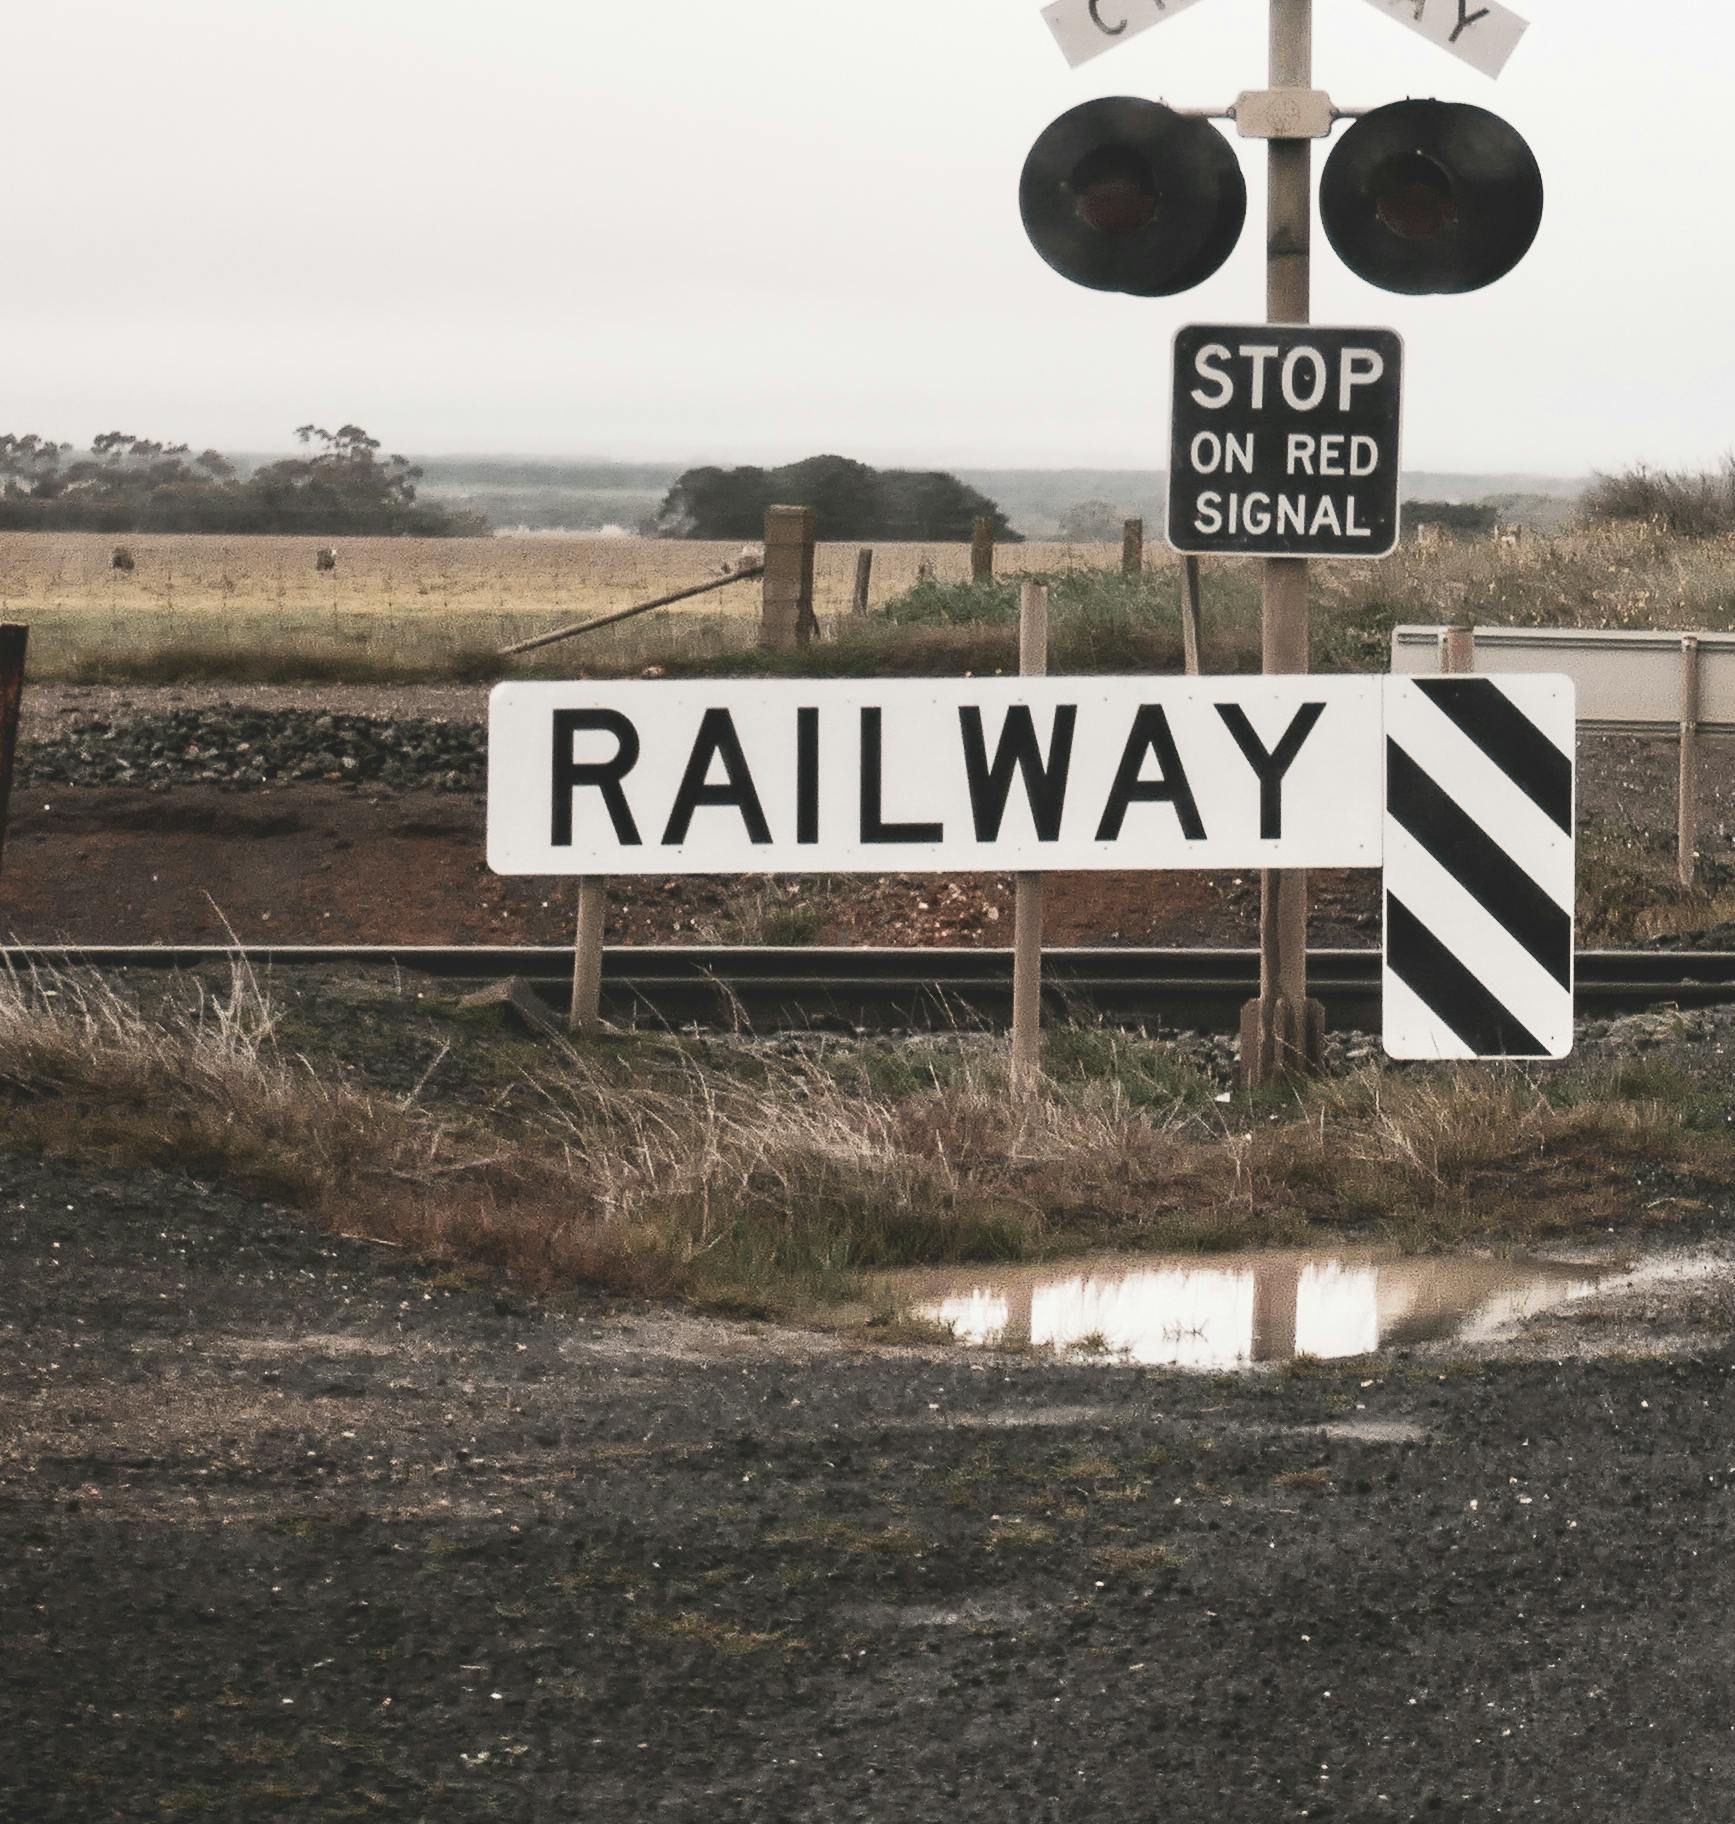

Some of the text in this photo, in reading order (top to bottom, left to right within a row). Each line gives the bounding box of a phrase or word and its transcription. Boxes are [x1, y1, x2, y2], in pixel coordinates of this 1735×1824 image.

[1190, 343, 1384, 412] STOP
[1190, 431, 1379, 476] ON RED
[1193, 491, 1371, 536] SIGNAL
[550, 701, 1326, 847] RAILWAY
